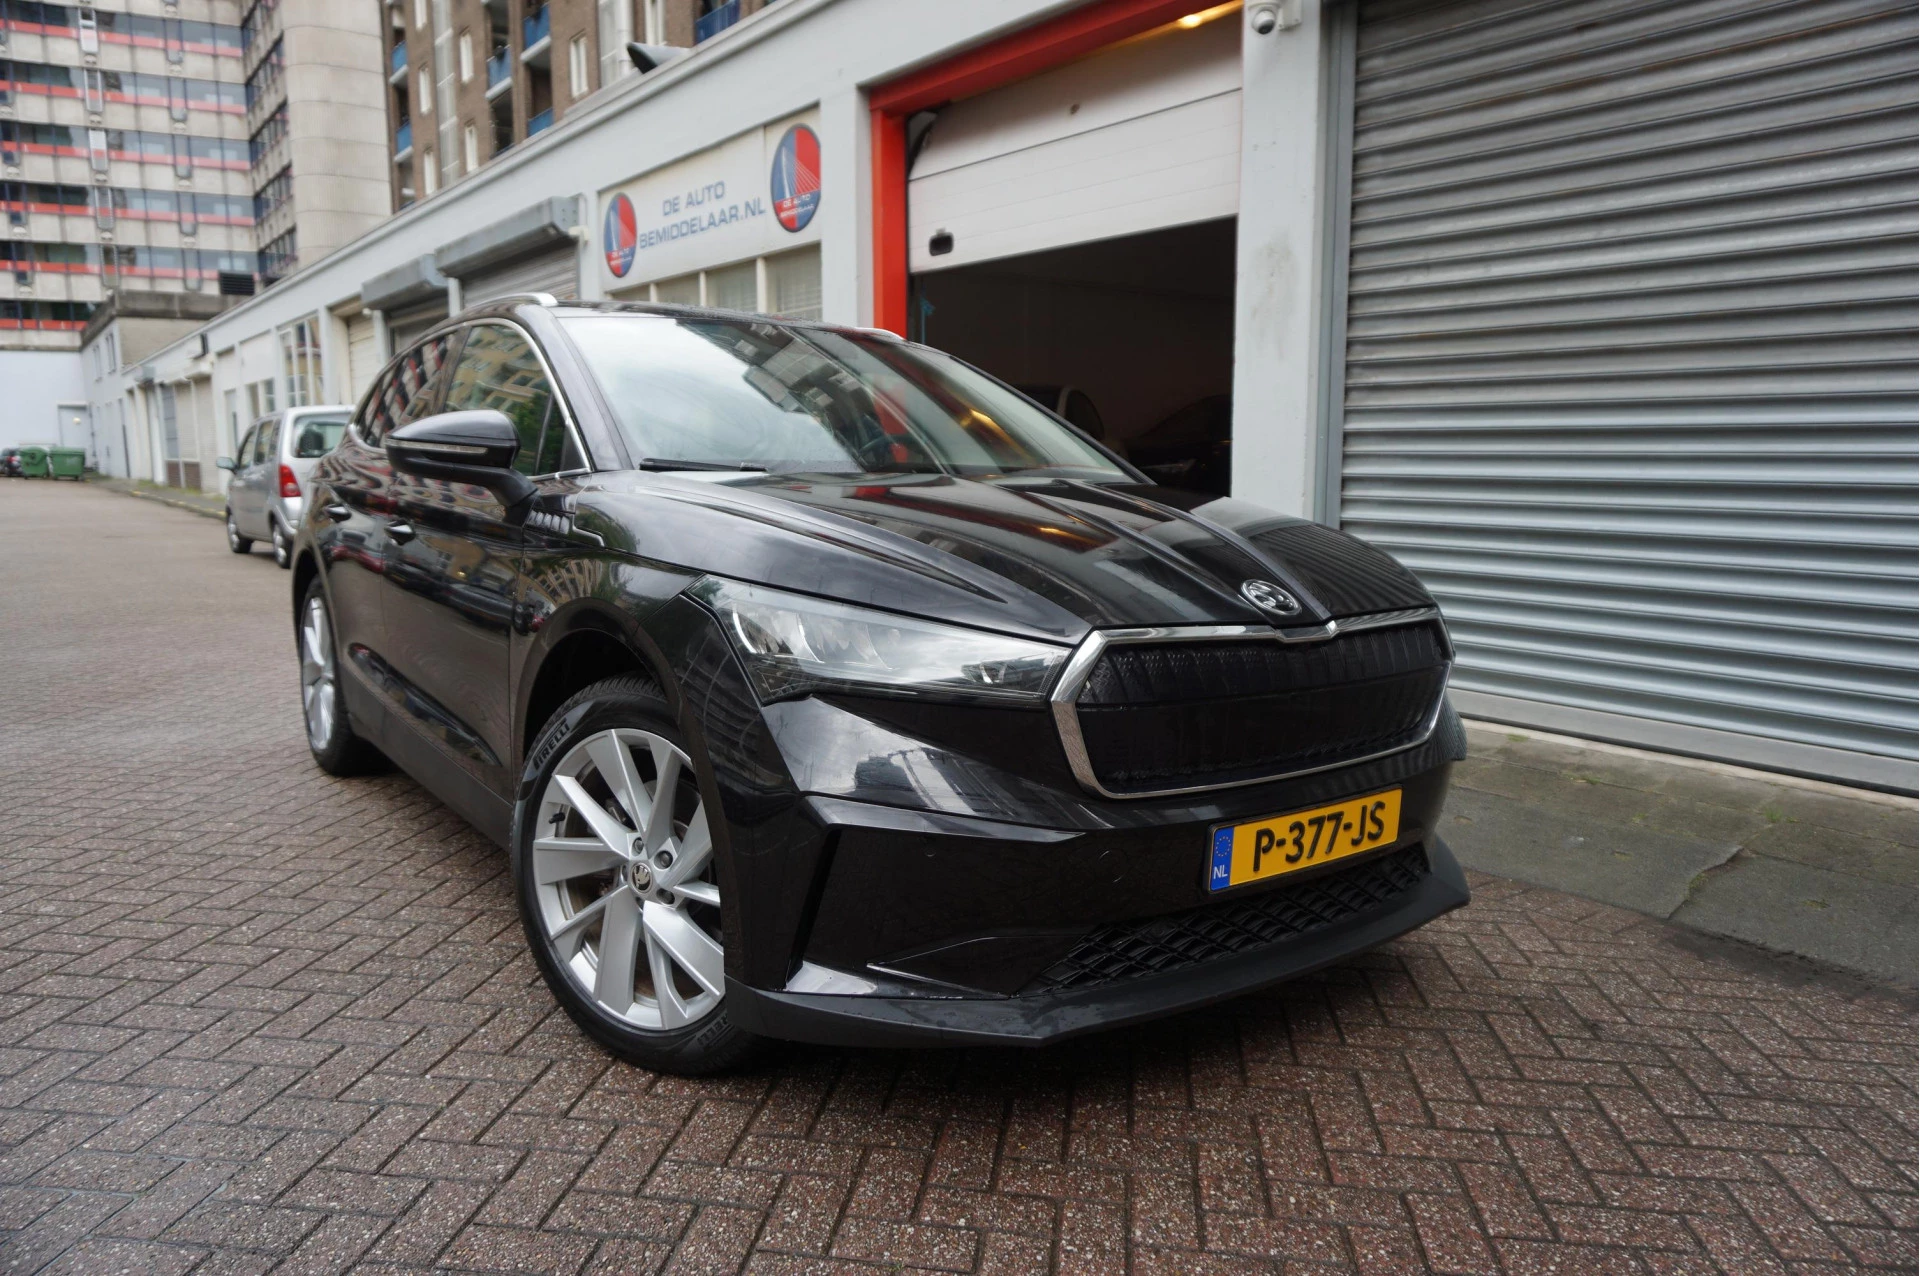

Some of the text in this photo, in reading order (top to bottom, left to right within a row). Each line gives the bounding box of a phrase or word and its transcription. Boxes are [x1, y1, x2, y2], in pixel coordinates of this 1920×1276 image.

[639, 197, 767, 250] BEMIDDELAAR.NL
[663, 180, 726, 216] DE AUTO
[533, 717, 570, 770] PIRELLI
[1253, 801, 1386, 873] P-377-JS
[1213, 864, 1228, 880] NL
